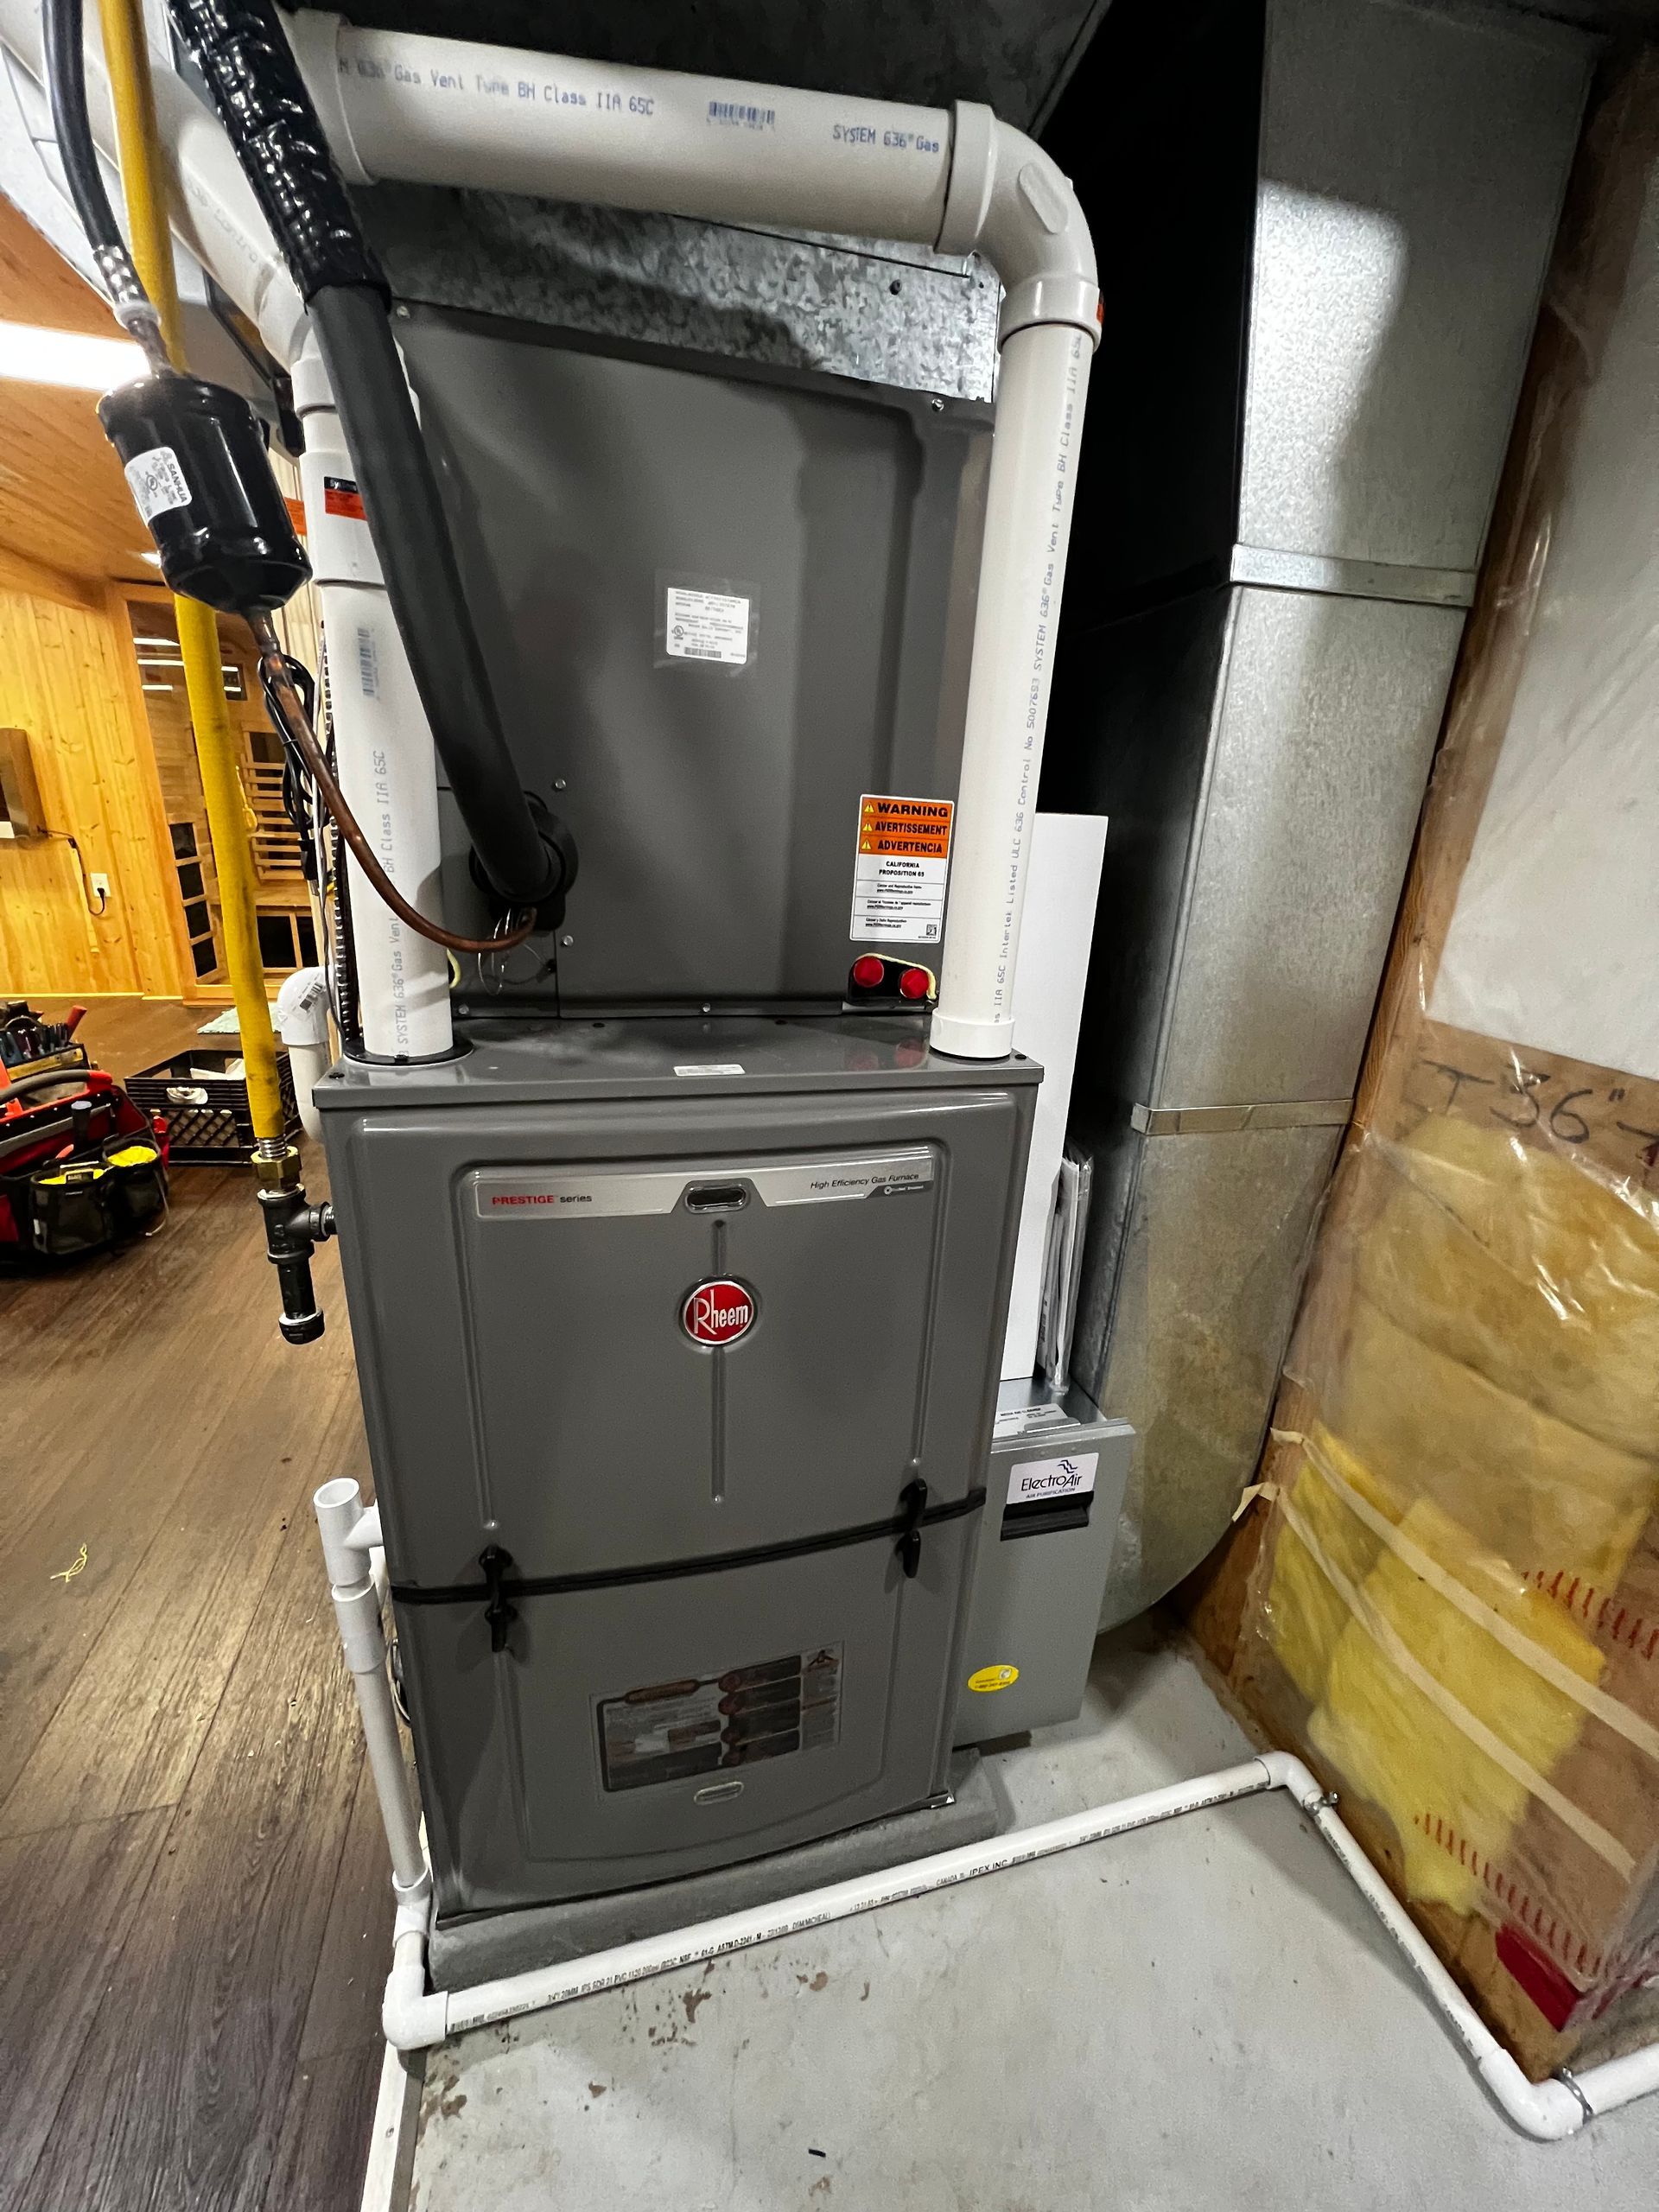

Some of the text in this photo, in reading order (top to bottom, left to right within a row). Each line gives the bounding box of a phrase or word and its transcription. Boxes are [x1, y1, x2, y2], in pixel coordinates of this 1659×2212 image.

[394, 64, 421, 85] Gas
[430, 69, 463, 91] Vent
[518, 81, 536, 101] BH
[543, 86, 587, 107] Class
[629, 97, 655, 116] 65C
[832, 124, 876, 145] SYSTEM
[916, 135, 939, 153] Gas
[1060, 403, 1073, 448] Class
[1057, 454, 1068, 474] BH
[168, 464, 188, 503] SANHUA
[1052, 480, 1065, 513] Type
[1046, 521, 1060, 553] Vent
[1042, 563, 1054, 587] Gas
[1033, 624, 1047, 671] SYSTEM
[1024, 734, 1033, 751] No
[373, 750, 386, 775] 65C
[1018, 758, 1032, 805] Control
[877, 802, 948, 817] WARNING
[380, 812, 393, 852] Class
[874, 822, 948, 836] AVERTISSEMENT
[1014, 812, 1025, 833] 636
[877, 840, 943, 854] ADVERTENCIA
[1011, 838, 1020, 861] ULC
[1005, 865, 1018, 906] Listed
[391, 951, 403, 972] Gas
[997, 964, 1006, 984] 65C
[395, 1005, 408, 1045] SYSTEM
[810, 1181, 830, 1190] High
[831, 1178, 869, 1187] Efficiency
[888, 1173, 919, 1182] Furnace
[492, 1194, 592, 1205] PRESTIGE series
[693, 1288, 748, 1335] Rheem
[1021, 1473, 1083, 1492] ElectroAir
[1037, 1487, 1076, 1497] PURIFICATION
[969, 1859, 1008, 1877] IPEX INC
